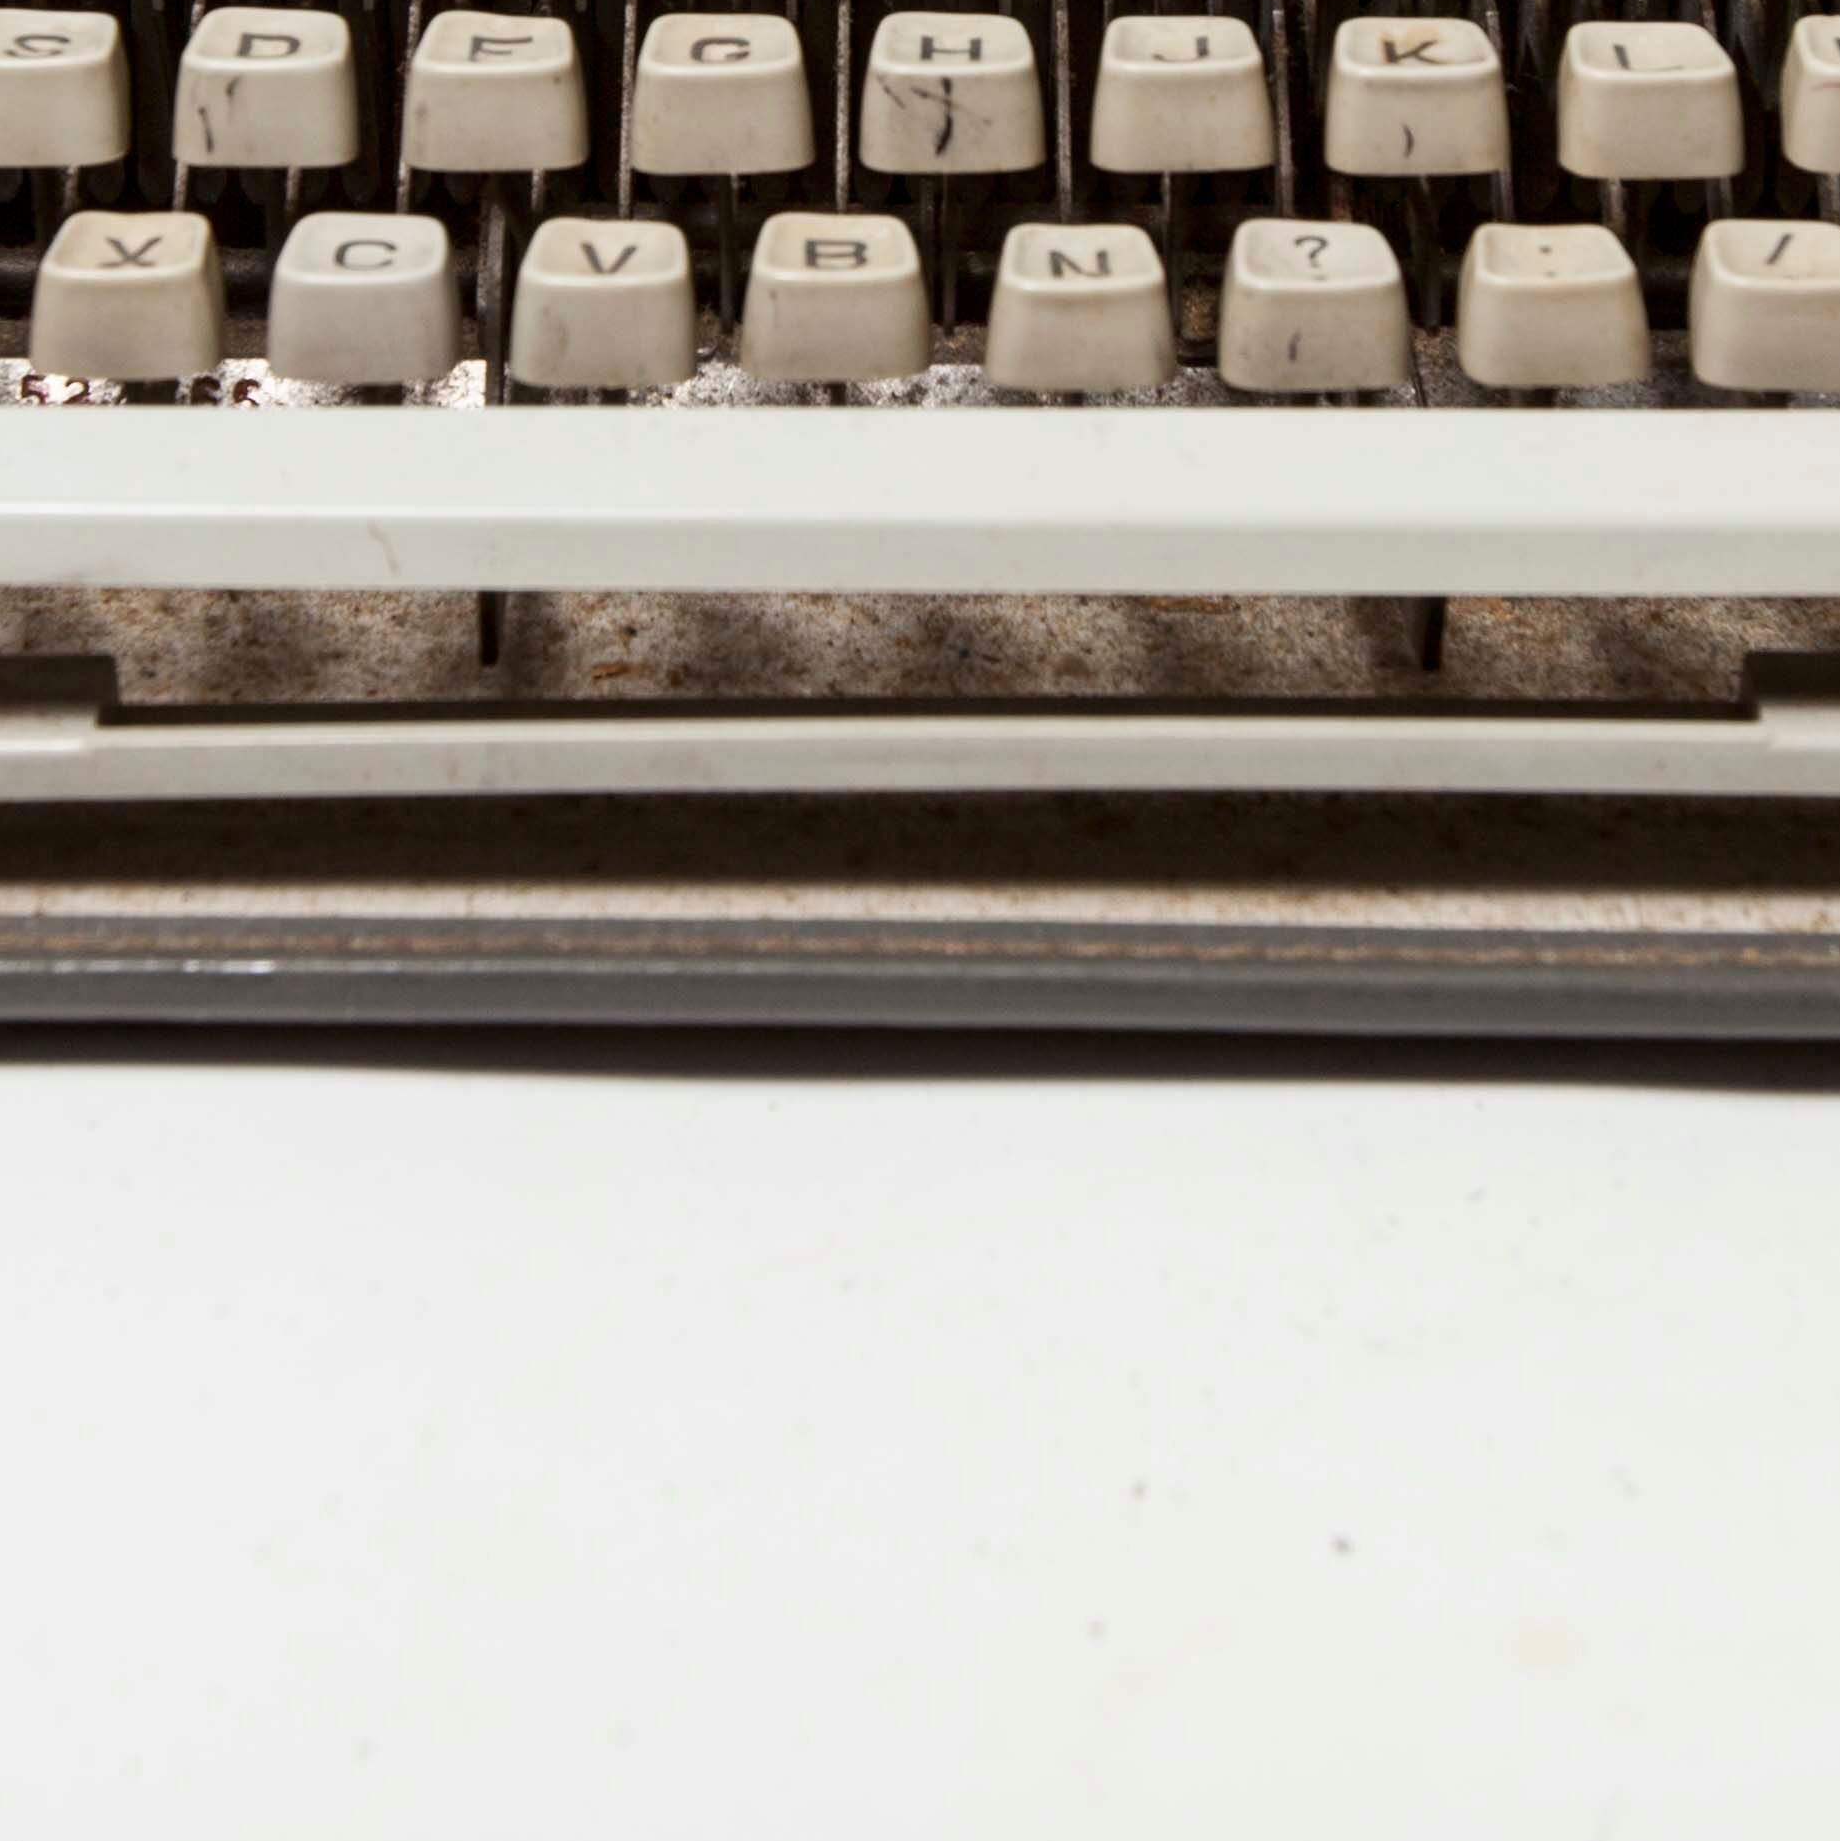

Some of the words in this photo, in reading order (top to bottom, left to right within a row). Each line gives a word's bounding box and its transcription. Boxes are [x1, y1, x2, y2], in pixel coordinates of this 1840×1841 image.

[5, 34, 71, 57] S
[236, 32, 301, 58] D
[469, 36, 533, 62] F
[690, 37, 750, 63] G
[920, 36, 982, 62] H
[1382, 40, 1438, 65] K
[102, 237, 162, 269] X
[334, 241, 397, 268] C
[581, 242, 637, 275] V
[804, 239, 868, 269] B
[1049, 250, 1110, 278] N
